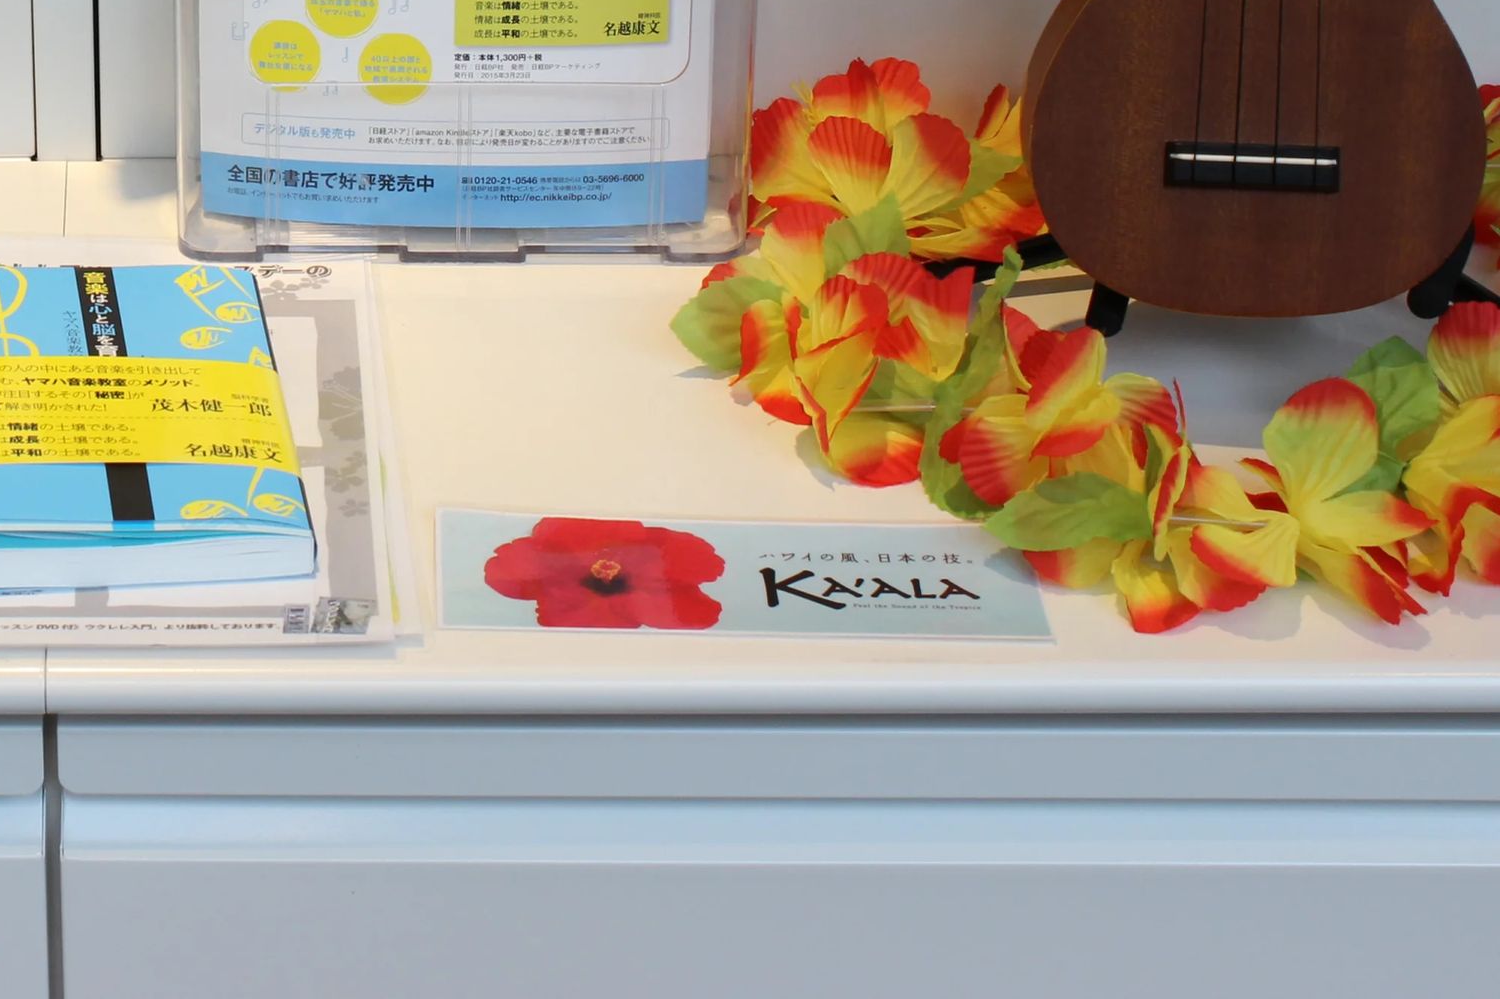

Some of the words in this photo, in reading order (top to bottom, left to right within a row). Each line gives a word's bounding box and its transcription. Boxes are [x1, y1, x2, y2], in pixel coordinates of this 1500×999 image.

[475, 1, 579, 11] 音楽は情緒の土壌である。
[474, 15, 579, 25] 情緒は成長の土壌である。
[474, 29, 579, 39] 成長は平和の土壌である。
[603, 21, 661, 37] 名越康文
[254, 123, 356, 140] デジタル版も発売中
[227, 163, 435, 194] 全国の書店で好評発売中
[474, 177, 538, 185] 0120-21-0546
[151, 398, 273, 418] 茂木健一郎
[184, 443, 283, 464] 名越康文
[758, 552, 974, 564] ハワイの風、日本の技。
[758, 567, 981, 610] KA'ALA
